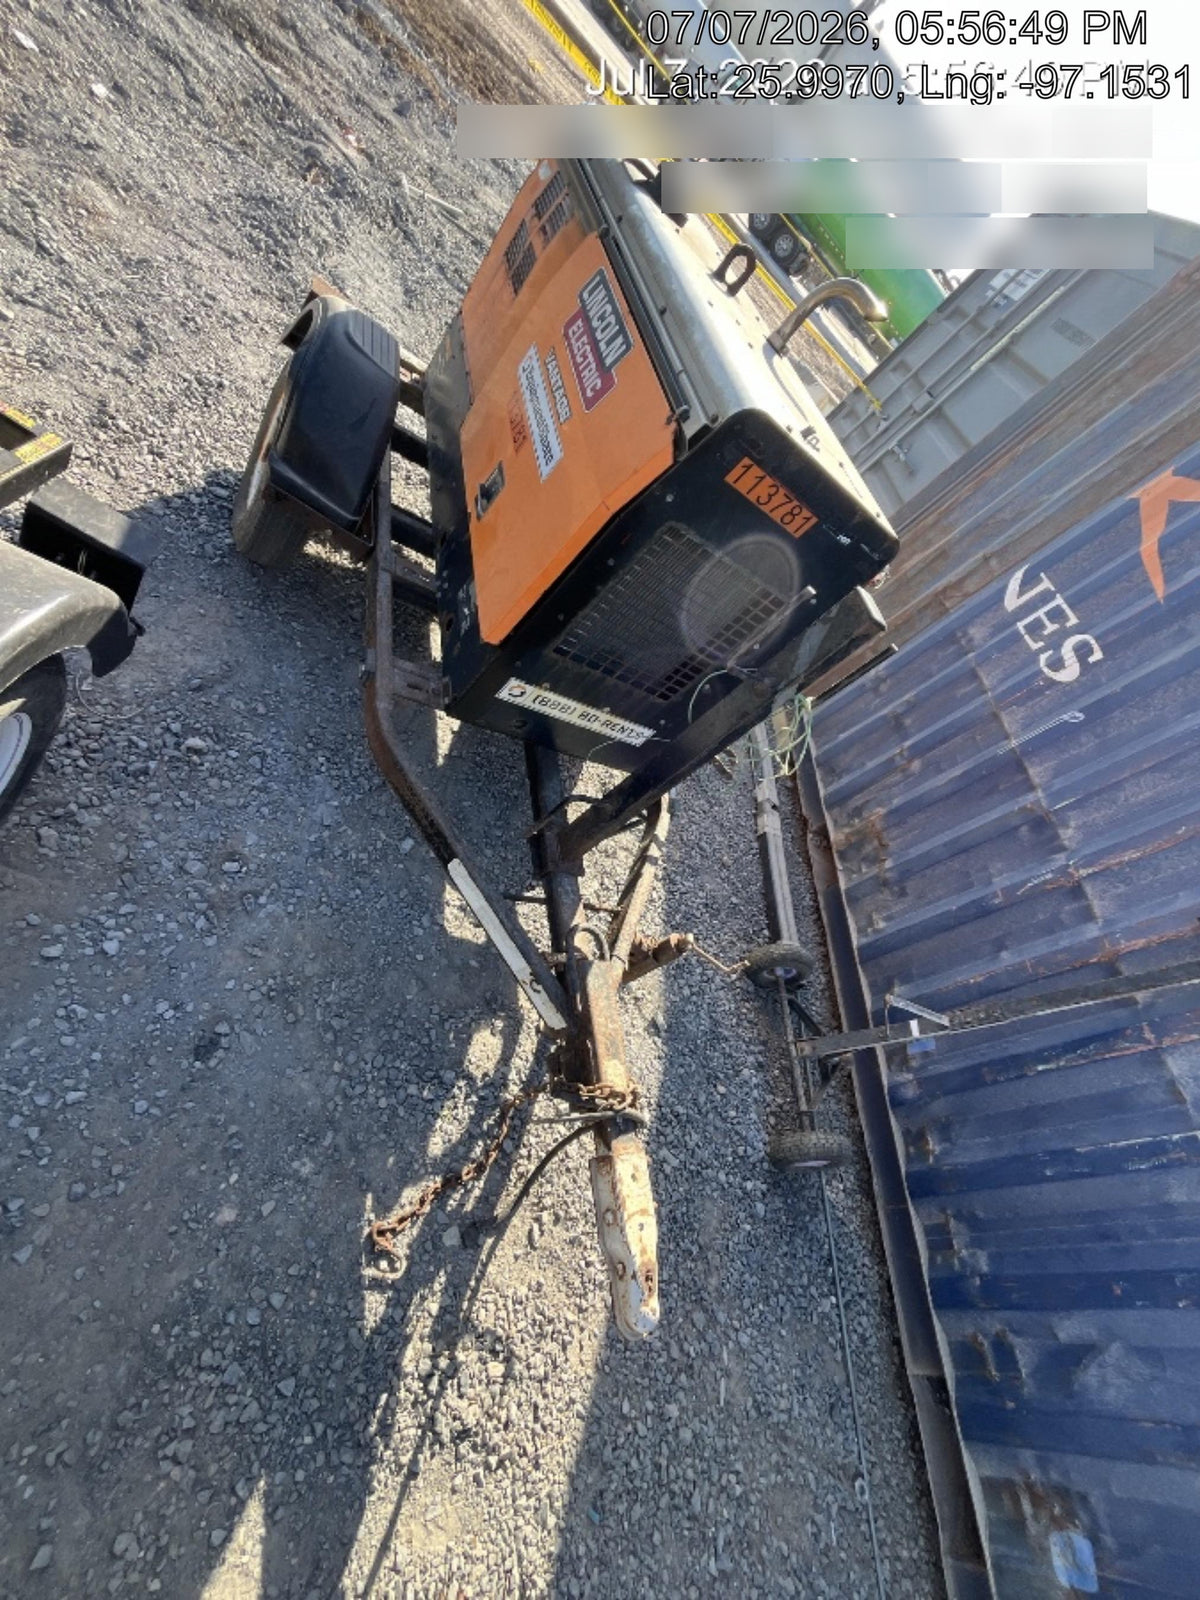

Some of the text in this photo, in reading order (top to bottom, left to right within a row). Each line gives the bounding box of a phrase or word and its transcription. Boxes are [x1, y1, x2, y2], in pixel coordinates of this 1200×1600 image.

[568, 317, 602, 398] ELECTRIC
[583, 275, 628, 368] LINCOLN
[732, 462, 814, 535] 113781
